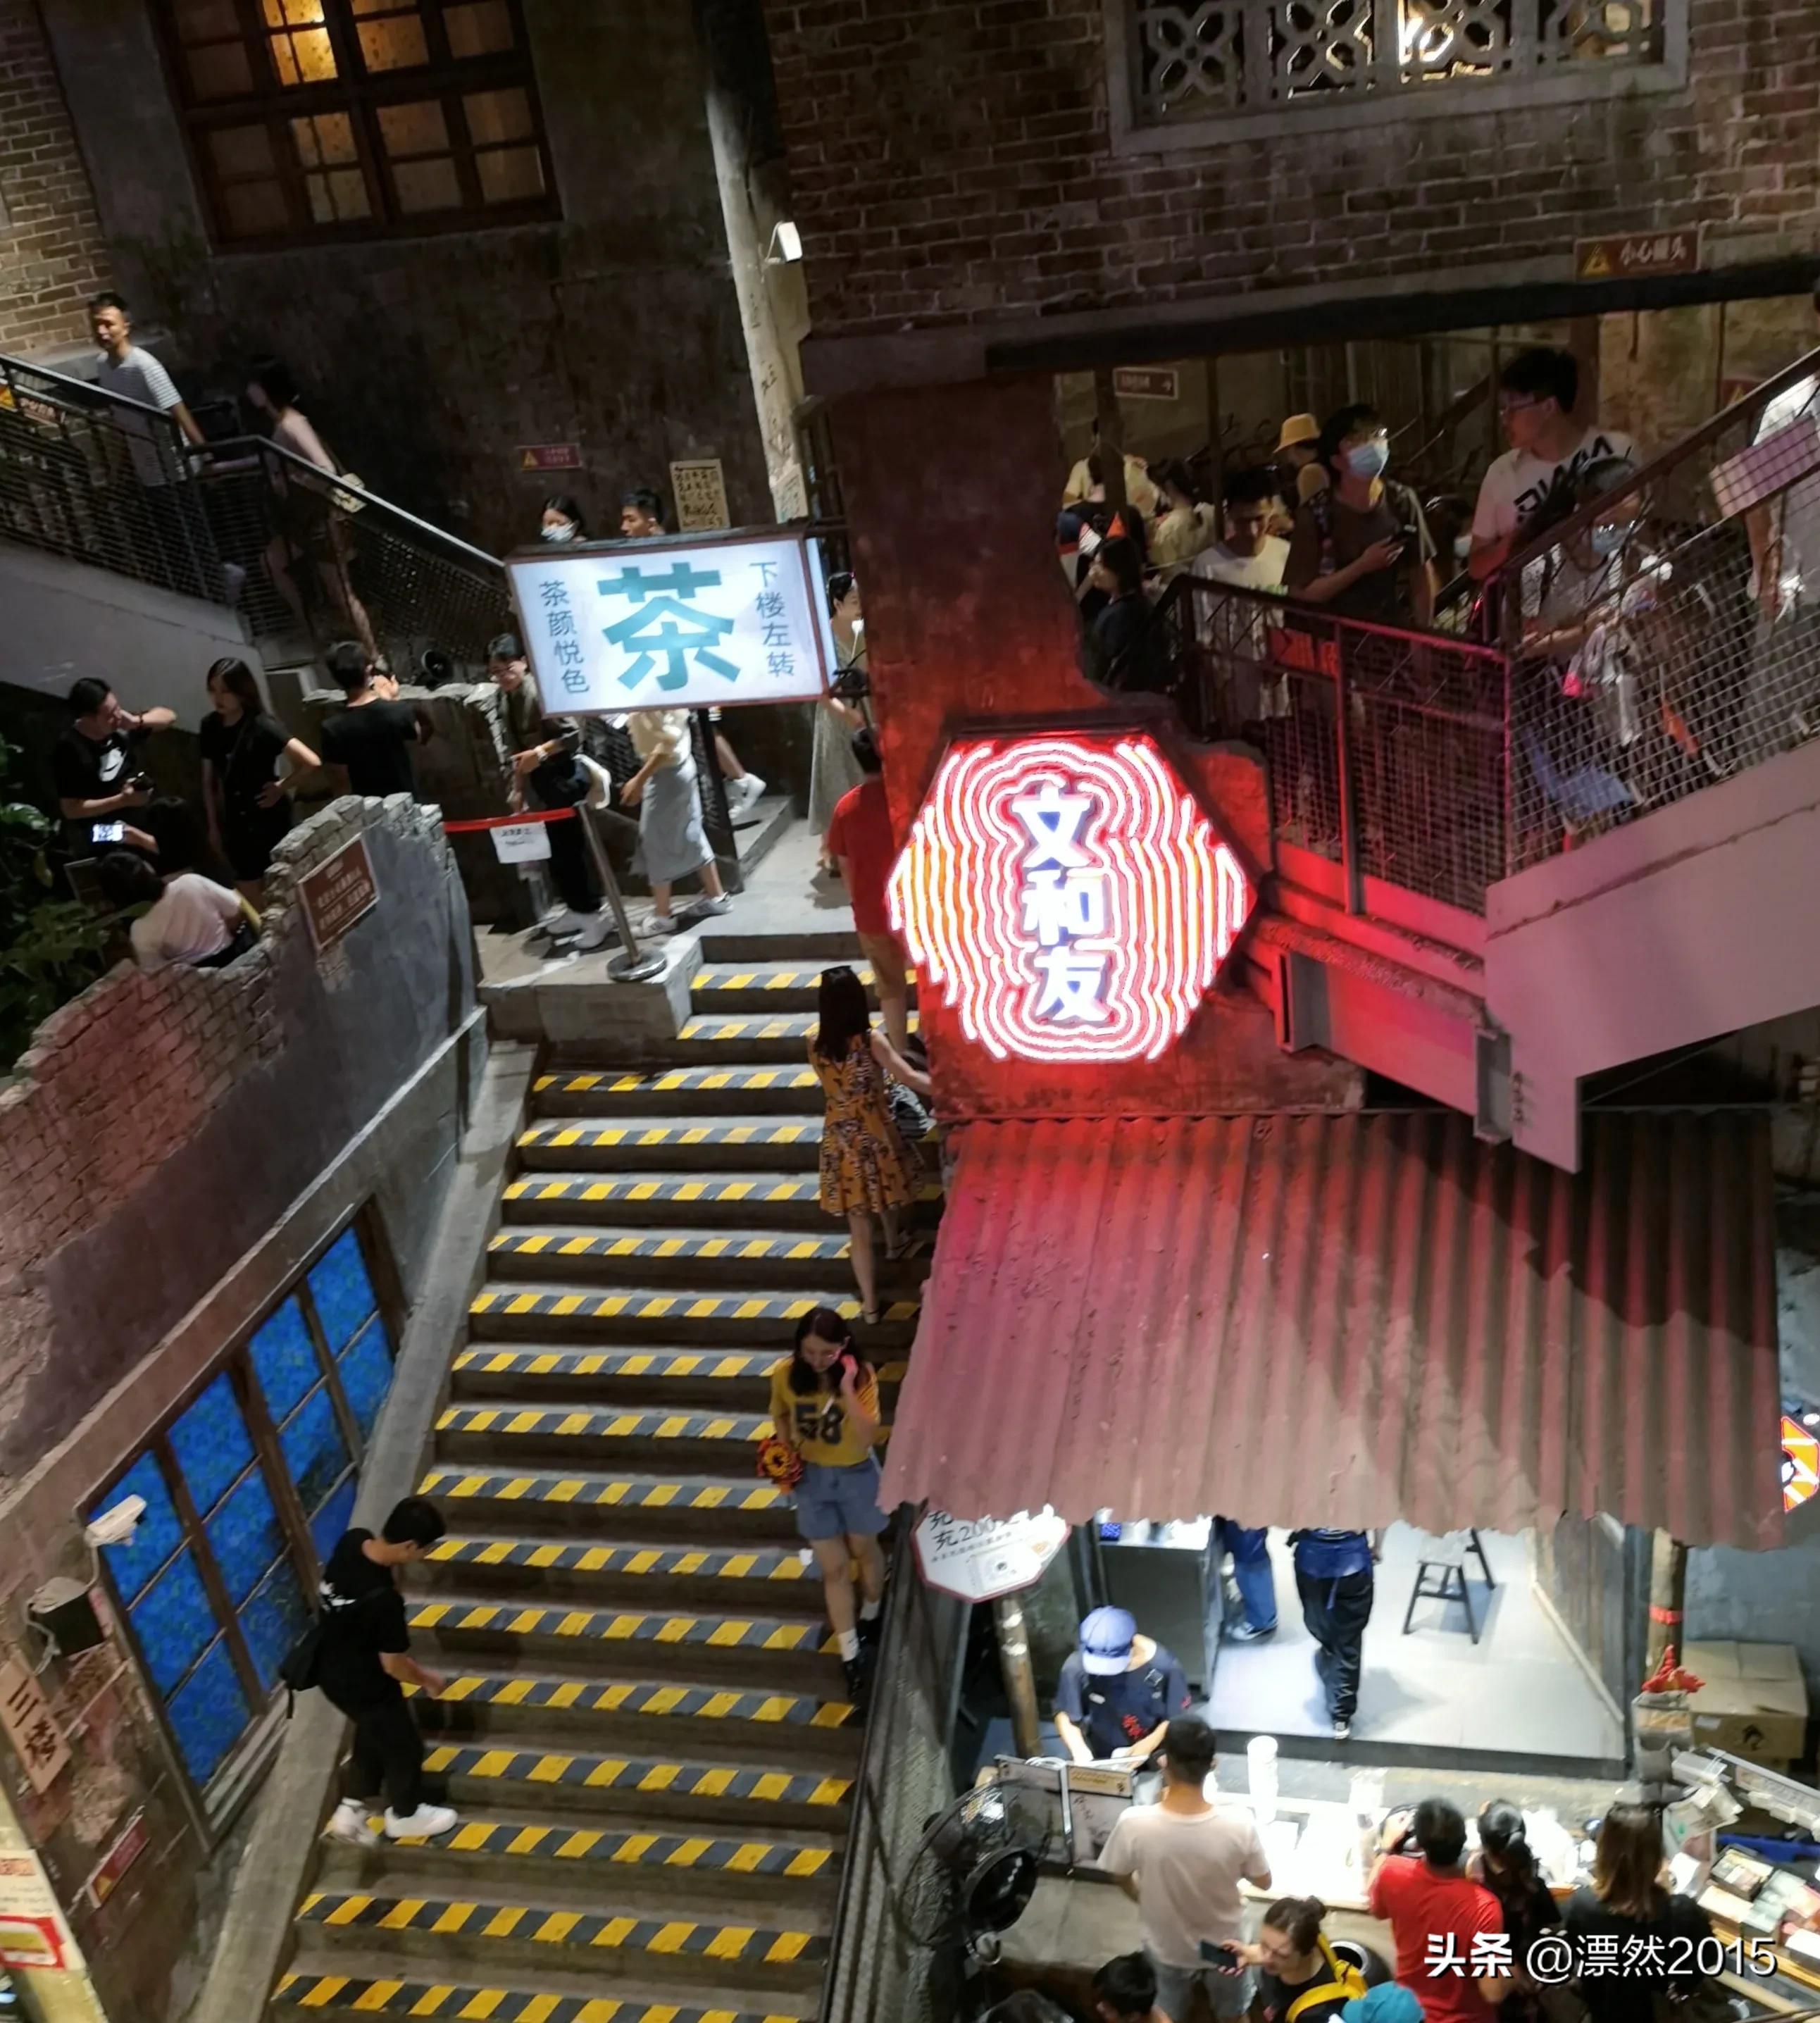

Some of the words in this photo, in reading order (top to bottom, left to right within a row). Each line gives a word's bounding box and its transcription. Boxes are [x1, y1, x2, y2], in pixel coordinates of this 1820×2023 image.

[539, 580, 590, 695] 茶颜悦色
[597, 562, 742, 691] 茶
[749, 561, 797, 678] 下楼左转
[1011, 784, 1109, 1021] 文和友
[796, 1402, 843, 1445] 58
